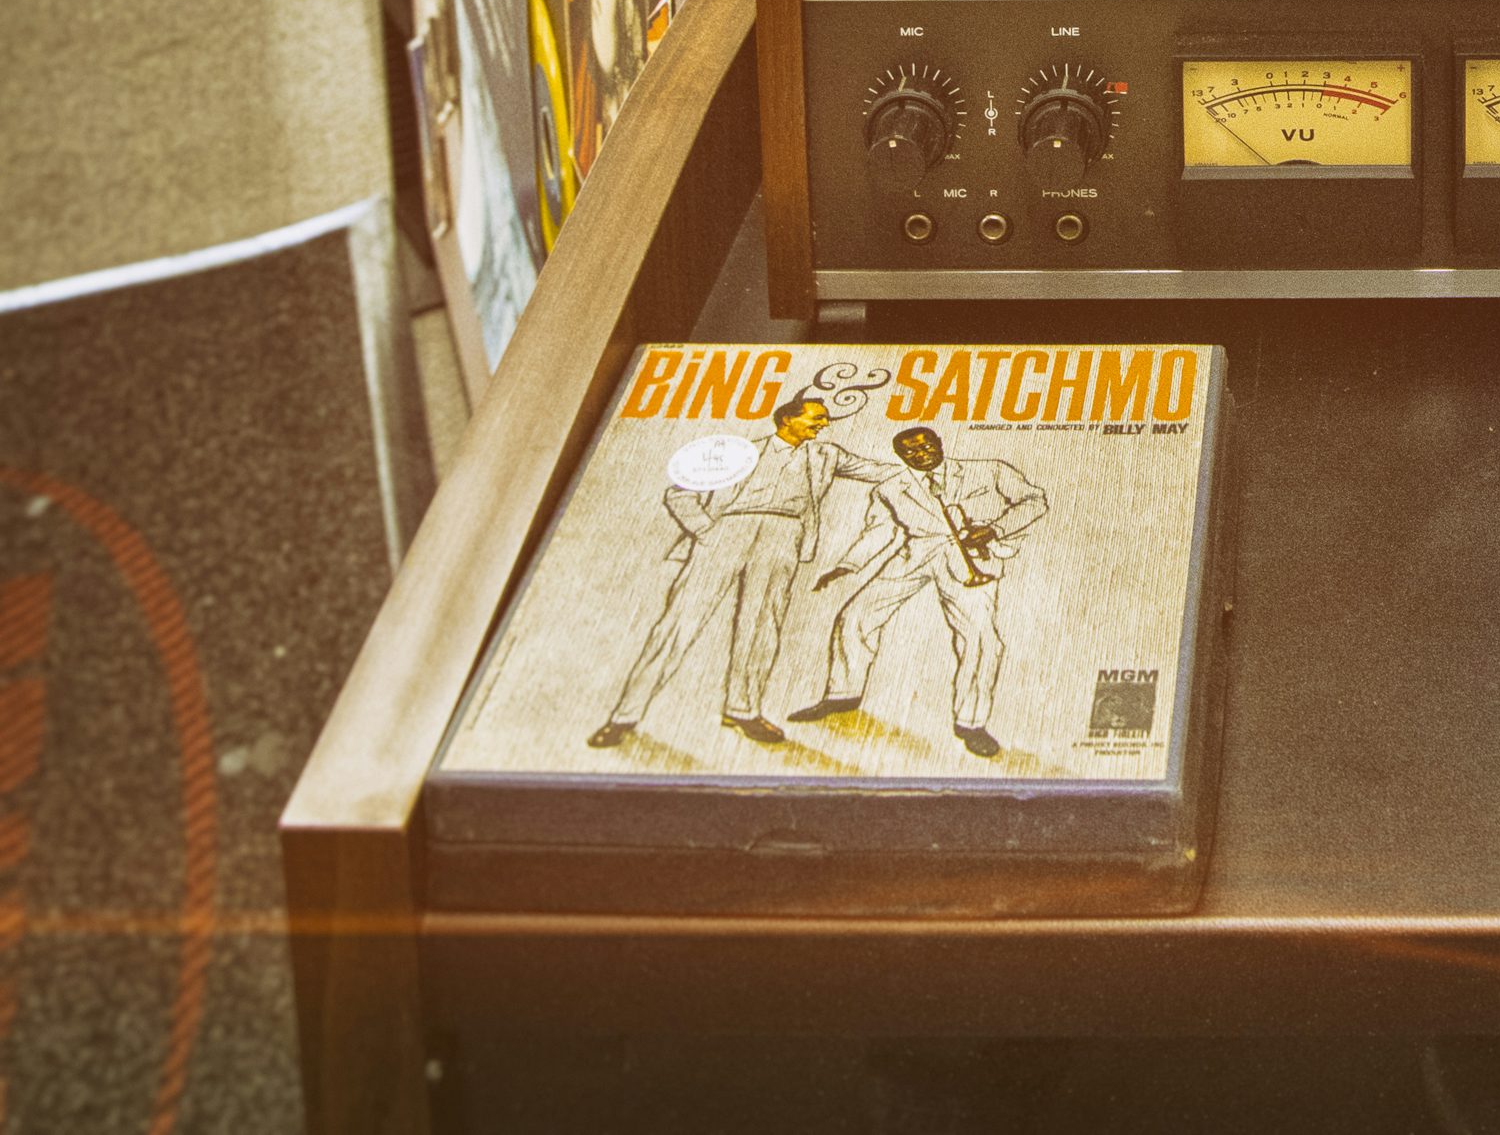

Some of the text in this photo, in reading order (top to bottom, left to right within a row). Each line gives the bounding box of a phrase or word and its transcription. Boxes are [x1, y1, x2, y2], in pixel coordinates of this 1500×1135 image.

[900, 27, 924, 36] MIC
[1051, 27, 1080, 36] LINE
[1192, 89, 1203, 97] 13
[1231, 78, 1239, 86] 3
[1323, 71, 1331, 79] 3
[1344, 75, 1352, 83] 4
[1370, 81, 1378, 89] 5
[1472, 88, 1484, 96] 13
[1323, 112, 1349, 121] NORMAL
[988, 128, 996, 136] R
[1281, 129, 1315, 142] VU
[914, 190, 921, 198] L
[943, 189, 967, 198] MIC
[885, 349, 1198, 422] SATCHMO
[1103, 424, 1146, 435] BILLY
[1152, 423, 1190, 434] MAY
[1097, 669, 1159, 682] MGM
